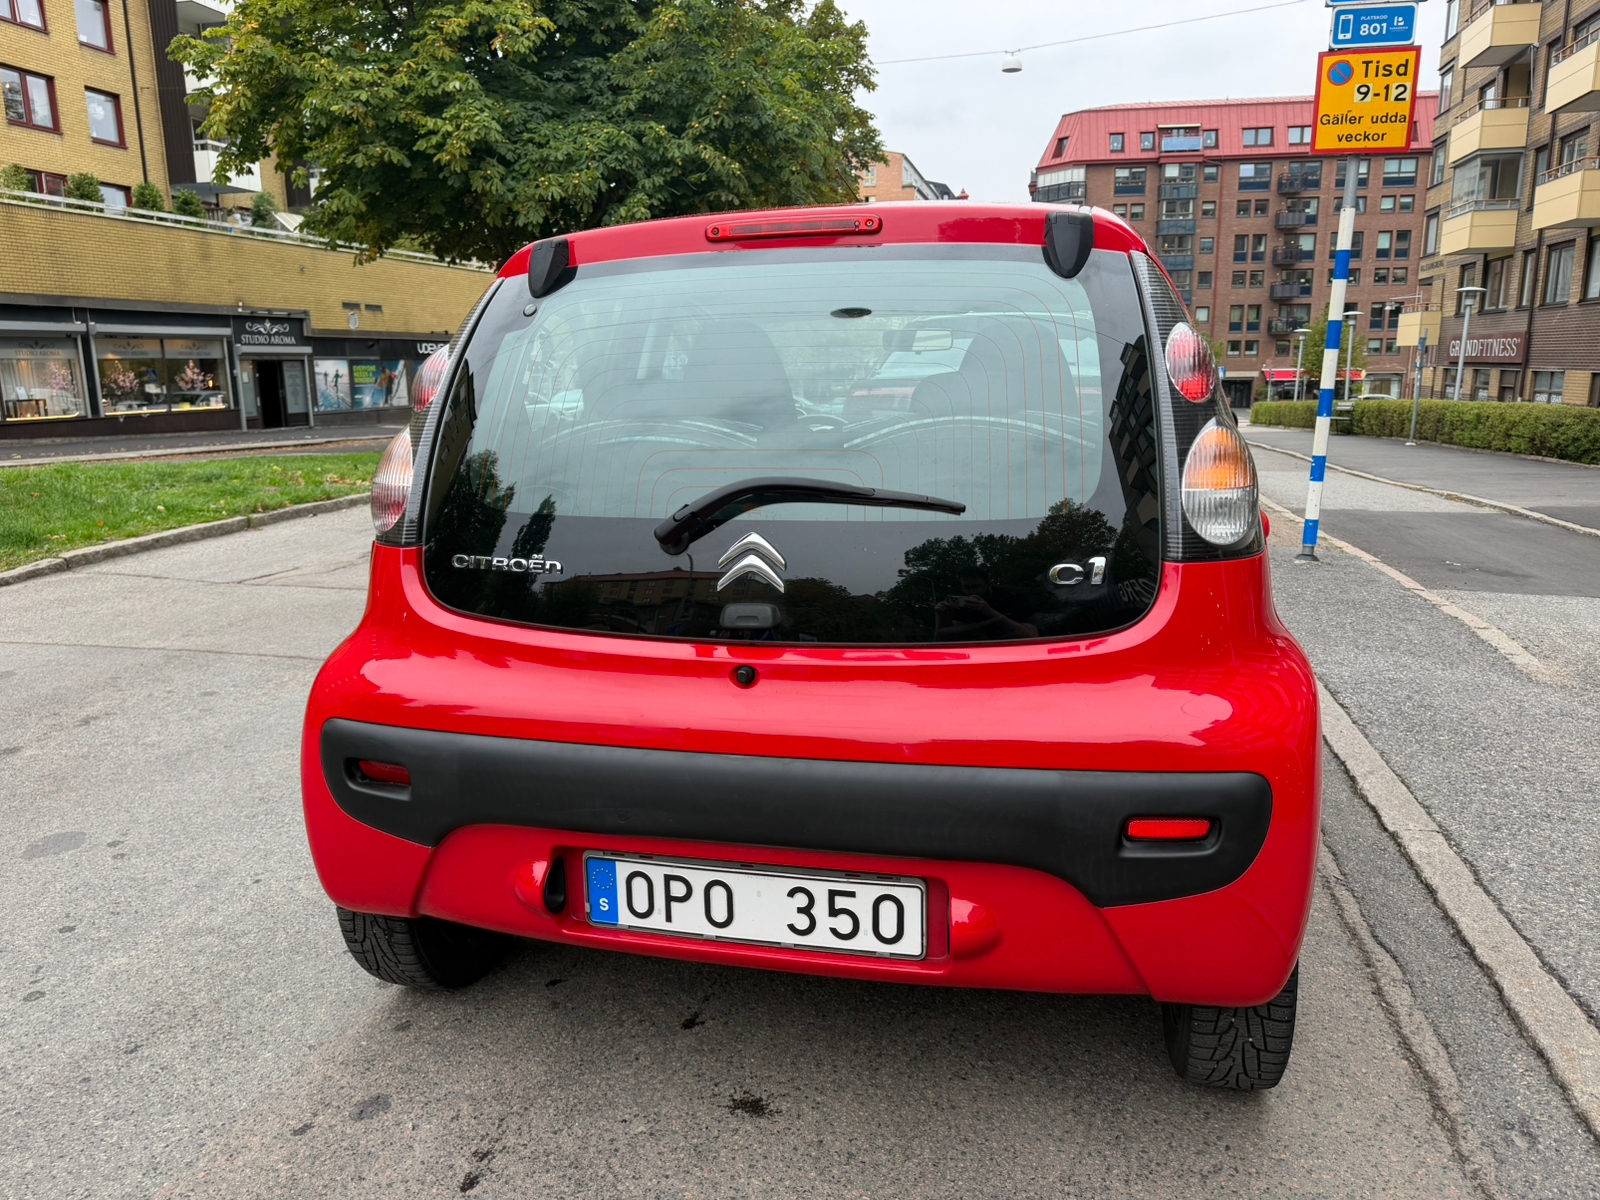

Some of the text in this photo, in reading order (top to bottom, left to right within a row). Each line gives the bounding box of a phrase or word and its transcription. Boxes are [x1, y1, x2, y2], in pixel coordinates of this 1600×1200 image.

[1360, 23, 1387, 36] 801
[1362, 59, 1410, 78] Tisd
[1356, 83, 1408, 102] 9-12
[1320, 112, 1407, 126] Gäller udda
[1337, 130, 1387, 142] veckor
[241, 334, 296, 345] STUDIO AROMA
[1449, 338, 1517, 357] GRNDFITNESS
[1049, 556, 1106, 584] C1
[600, 898, 609, 911] S
[625, 870, 905, 945] OPO 350
